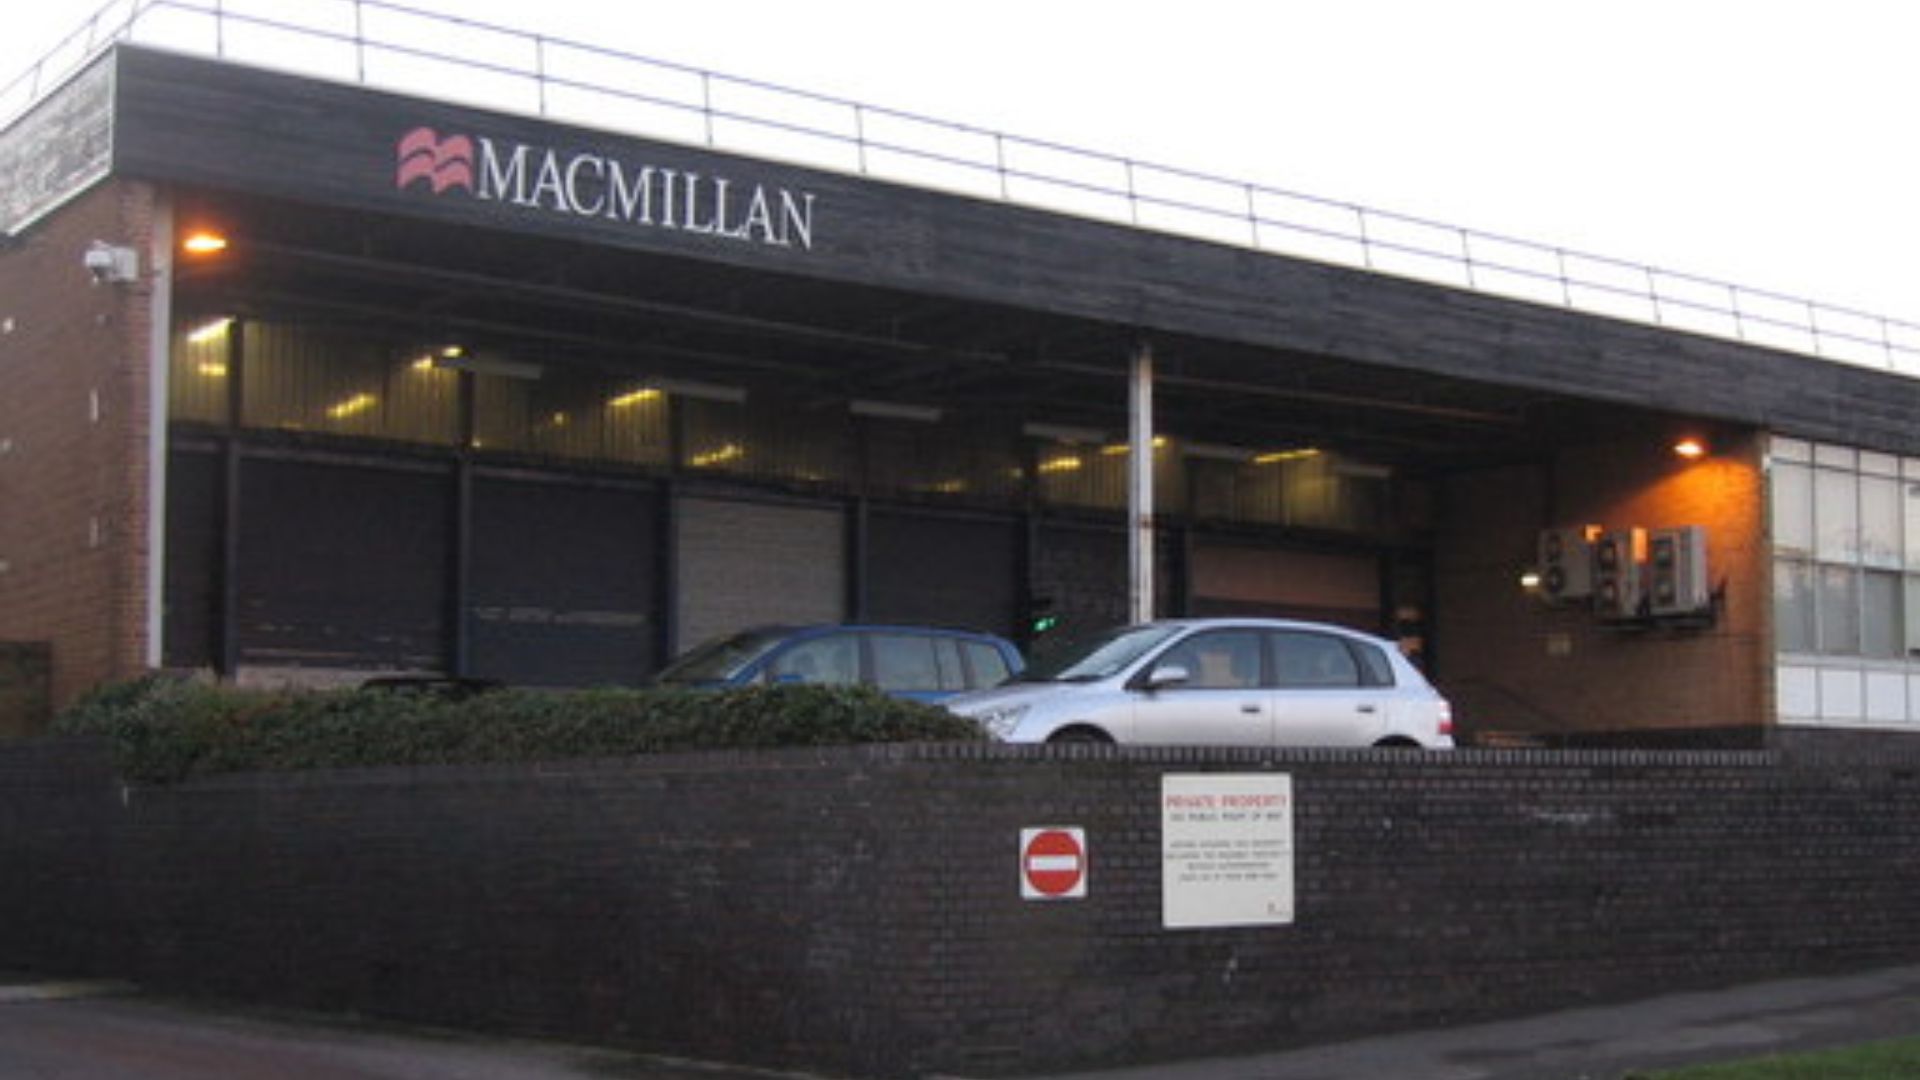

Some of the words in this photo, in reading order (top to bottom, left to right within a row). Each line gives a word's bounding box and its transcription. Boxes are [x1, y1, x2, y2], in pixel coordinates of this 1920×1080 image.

[477, 137, 815, 250] MACMILLAN
[1166, 795, 1217, 808] PRIVATE
[1221, 794, 1287, 807] PROPERTY
